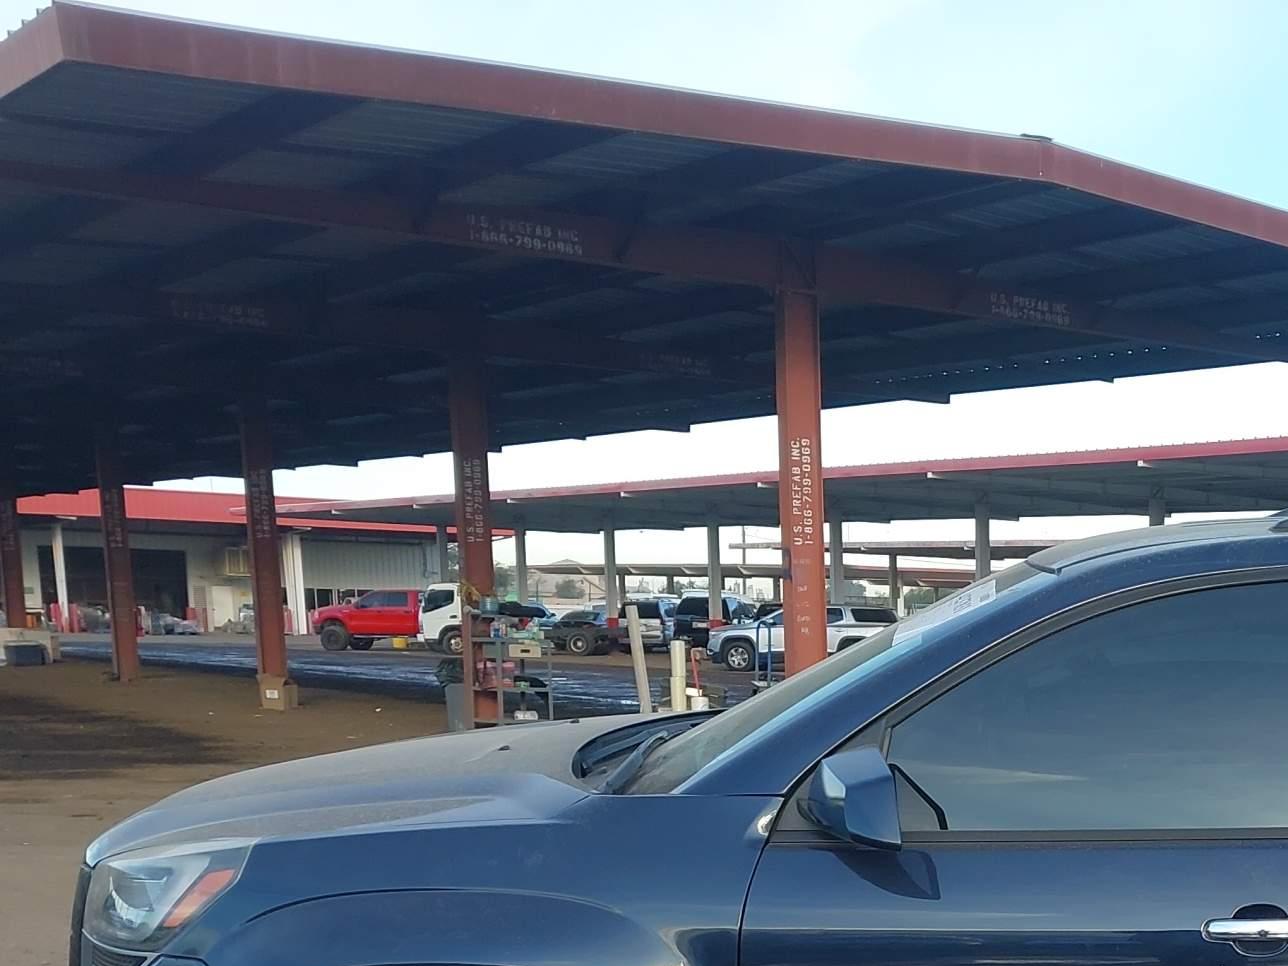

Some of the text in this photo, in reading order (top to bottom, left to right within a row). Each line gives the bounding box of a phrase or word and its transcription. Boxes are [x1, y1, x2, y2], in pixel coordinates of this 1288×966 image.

[790, 437, 803, 546] U.S. PREFAB INC.
[801, 438, 814, 544] 1-866-799-0969
